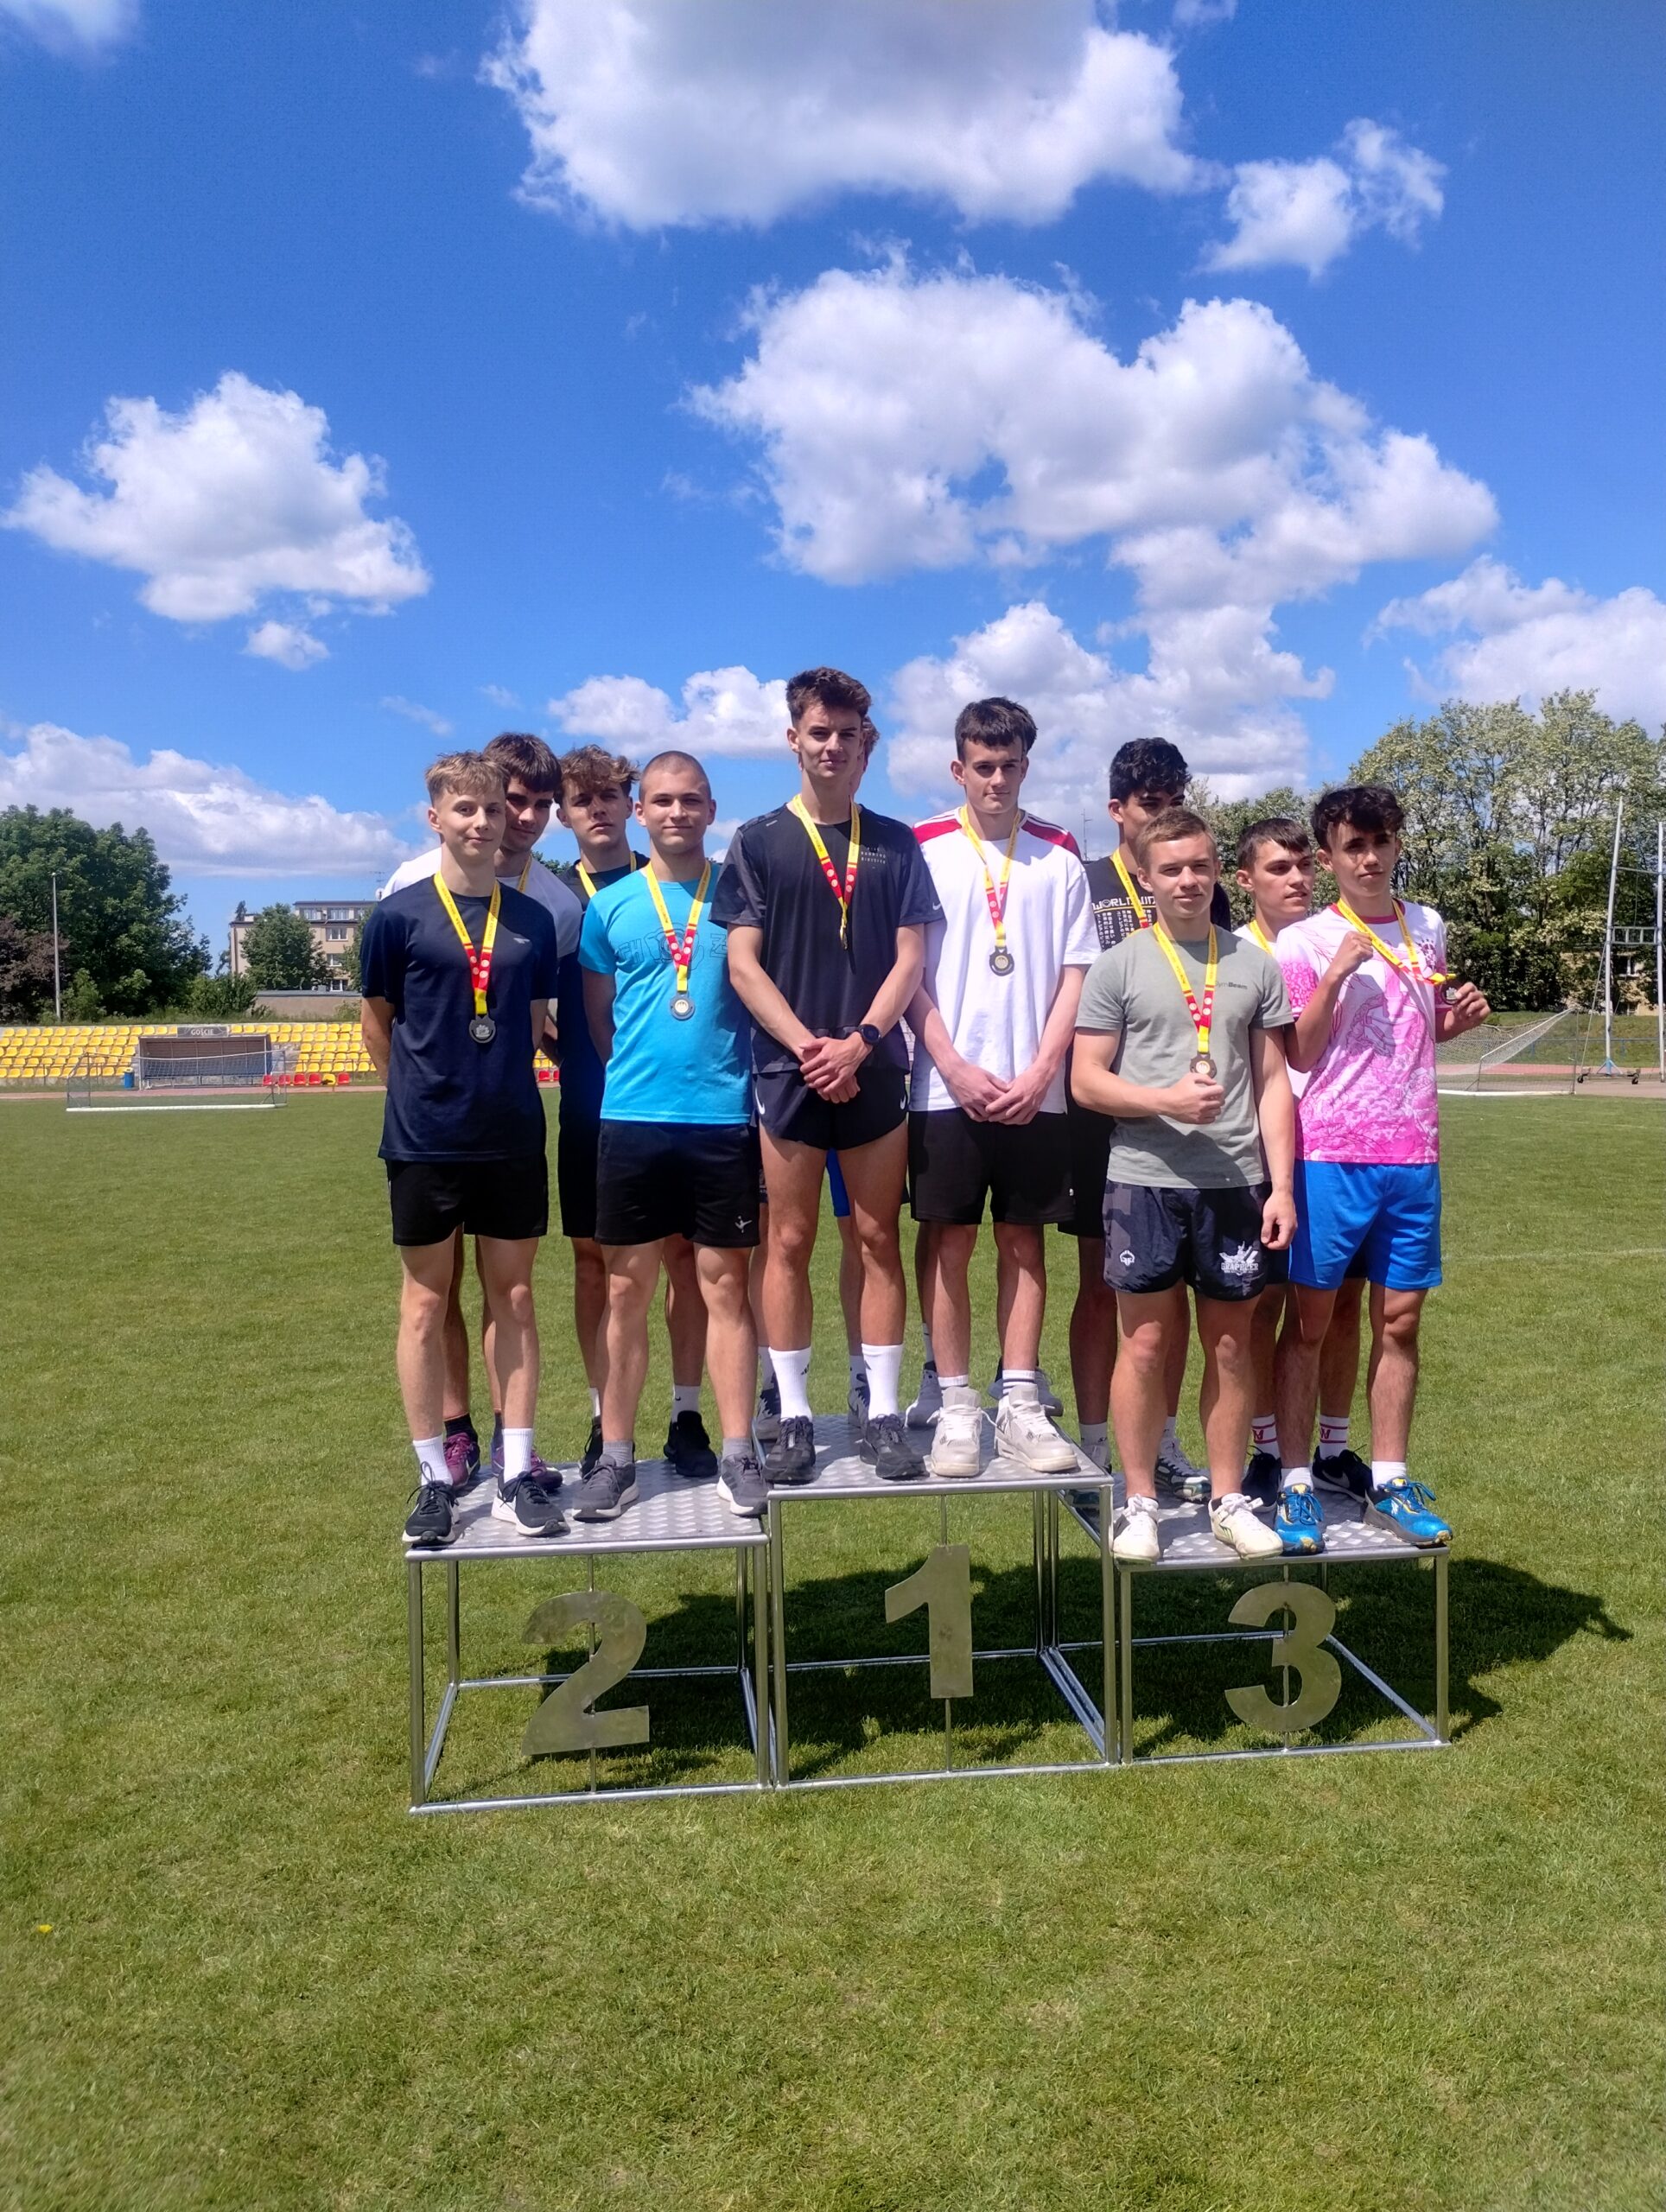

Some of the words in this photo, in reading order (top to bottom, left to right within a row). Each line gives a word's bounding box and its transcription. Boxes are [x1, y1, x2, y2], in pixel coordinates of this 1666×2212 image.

[521, 1591, 650, 1756] 2
[885, 1544, 974, 1699] 1
[1224, 1582, 1341, 1732] 3
